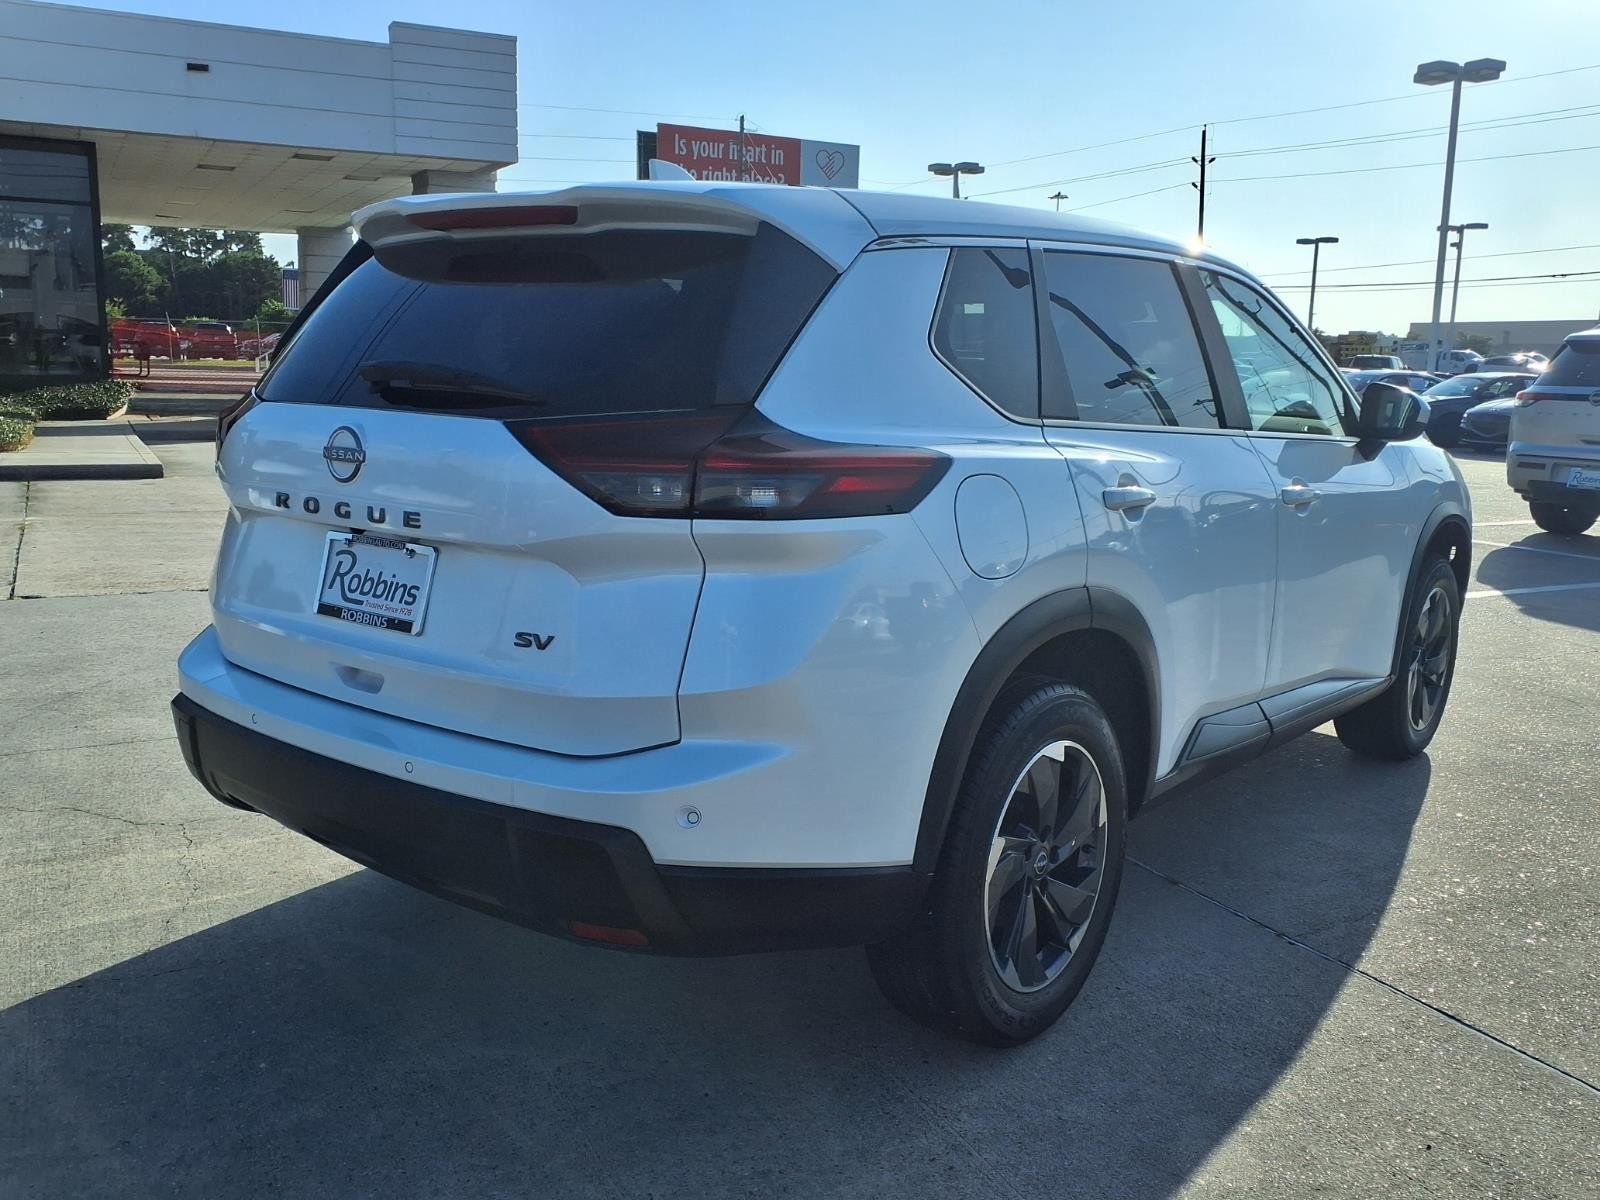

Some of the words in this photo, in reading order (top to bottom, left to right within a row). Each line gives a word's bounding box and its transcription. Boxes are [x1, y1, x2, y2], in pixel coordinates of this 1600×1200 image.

[674, 133, 687, 155] Is
[691, 140, 725, 160] your
[771, 144, 784, 166] in
[324, 448, 364, 462] NISSAN
[275, 491, 422, 529] ROGUE
[328, 549, 420, 606] Robbins
[364, 600, 384, 610] Trusted
[340, 608, 388, 628] ROBBINS
[513, 631, 556, 651] SV
